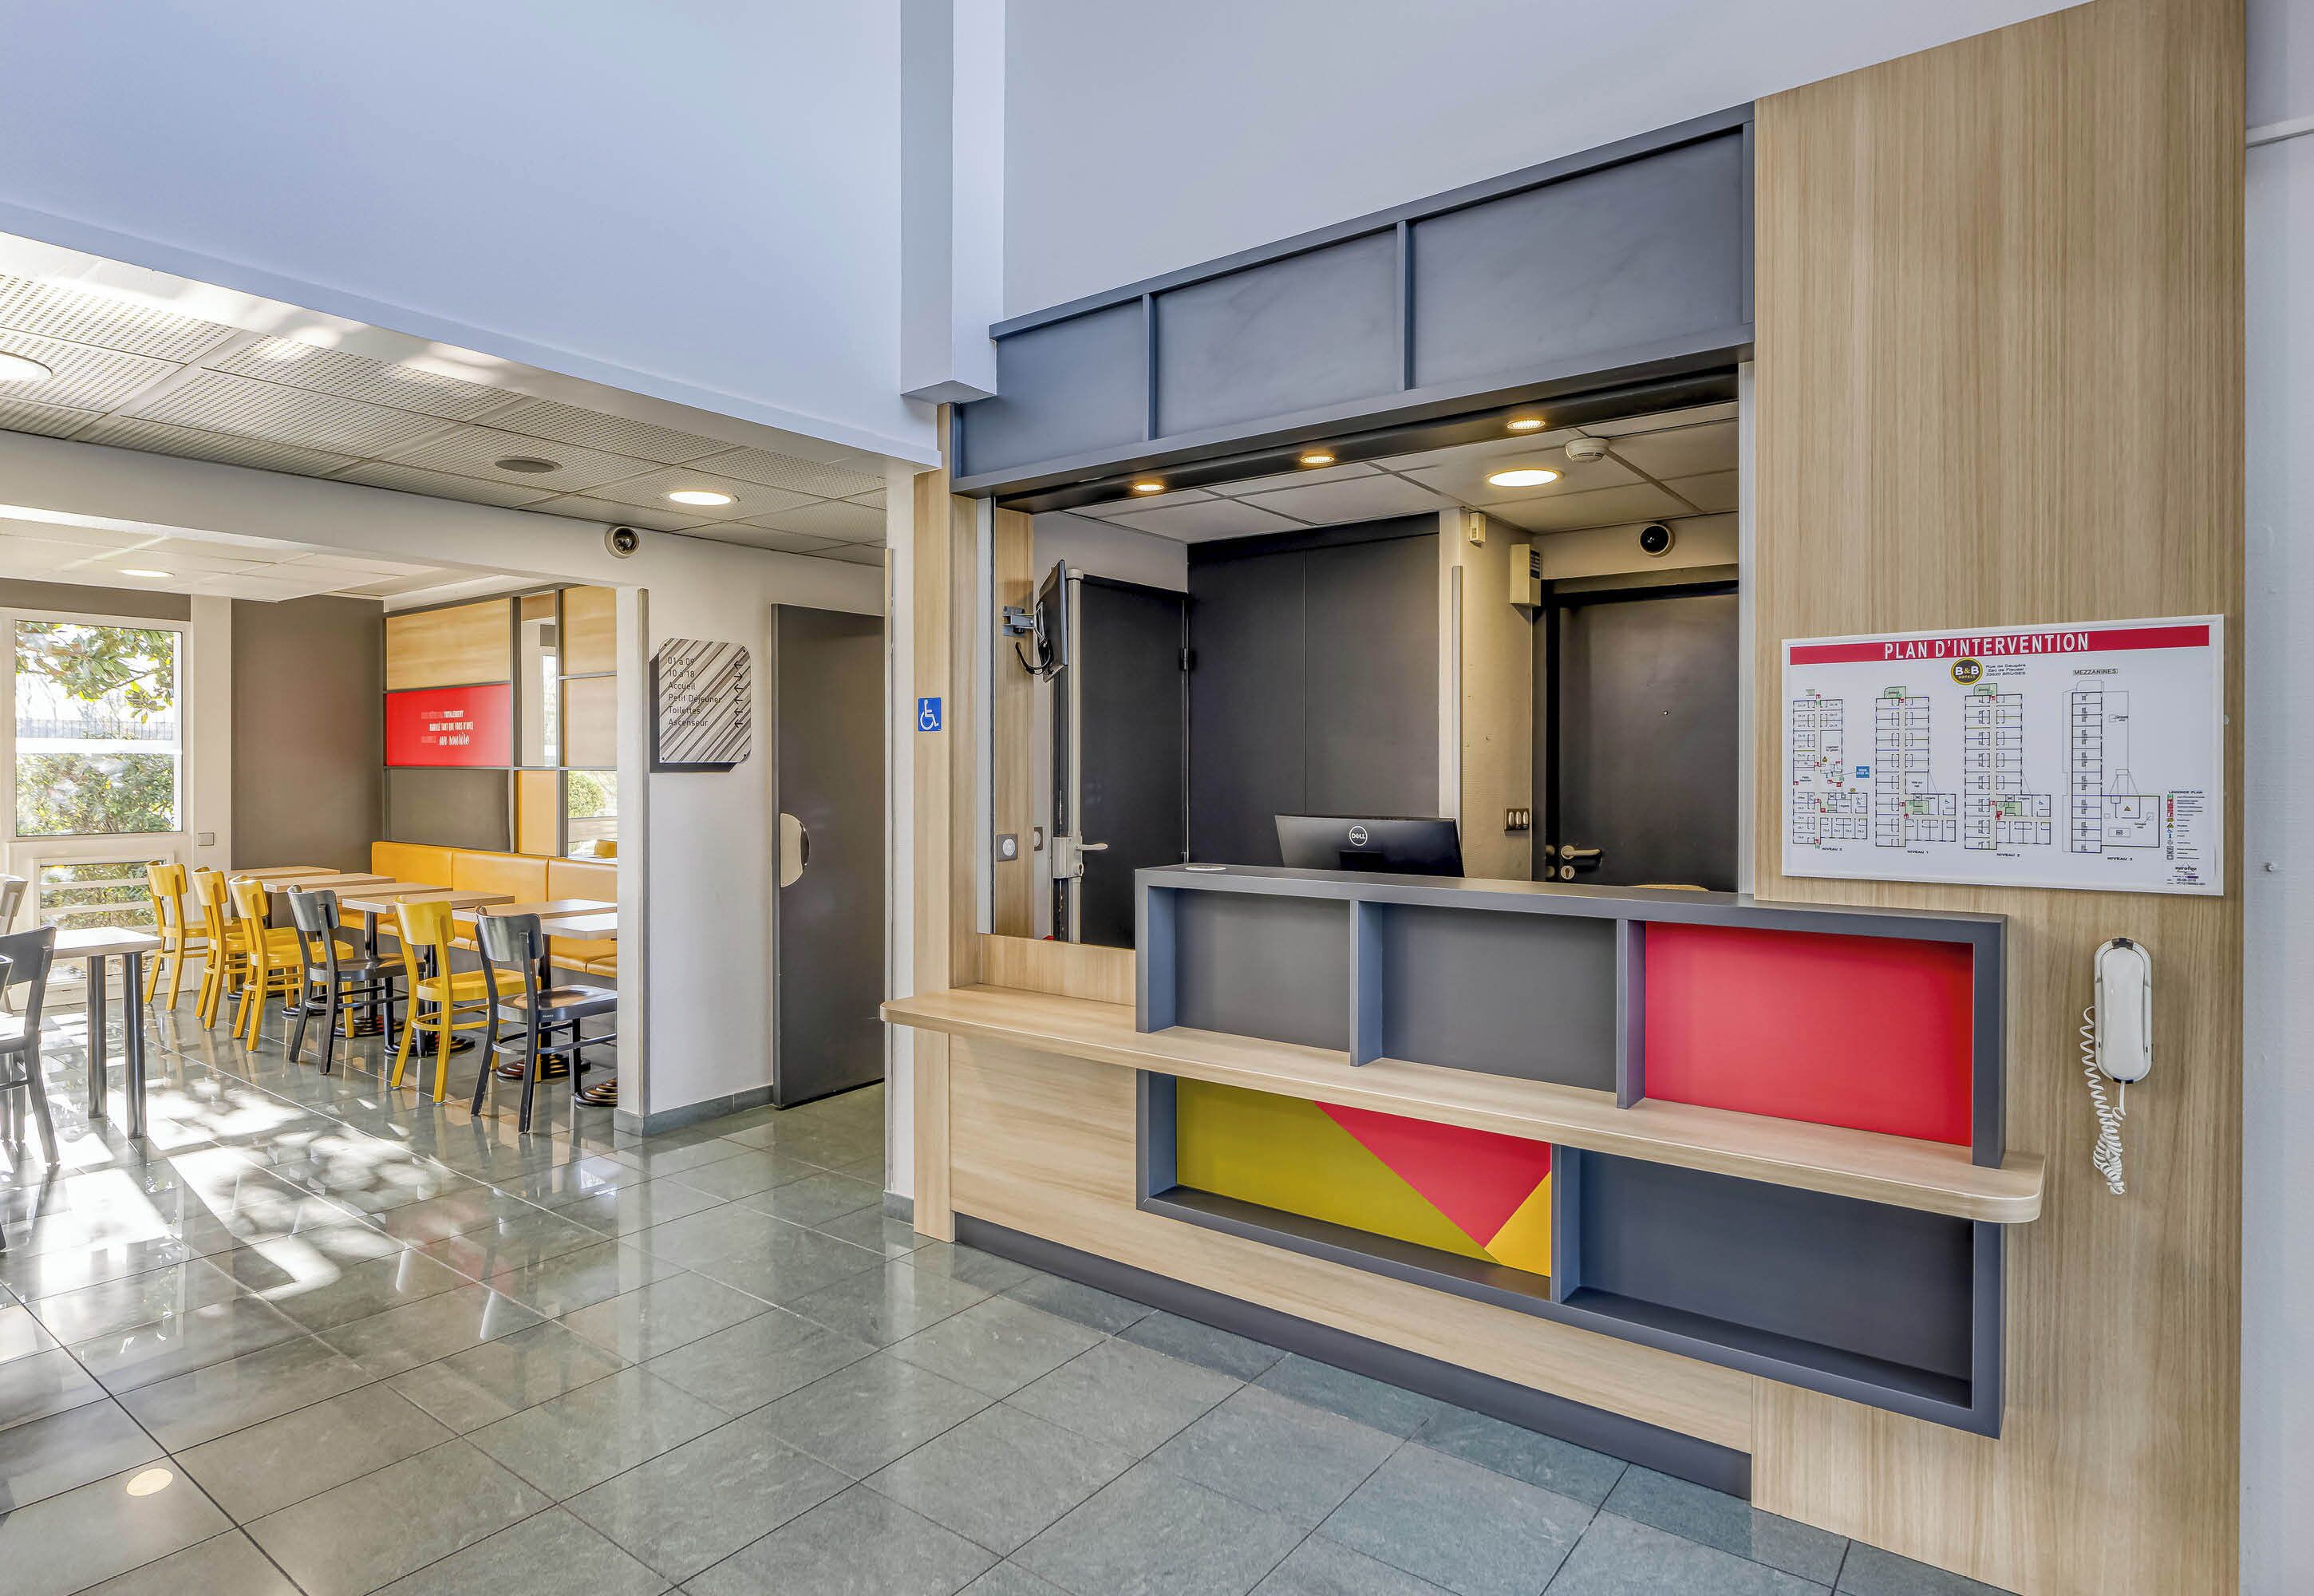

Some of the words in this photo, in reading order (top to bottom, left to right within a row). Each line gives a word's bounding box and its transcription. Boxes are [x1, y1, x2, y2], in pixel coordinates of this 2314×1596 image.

[1885, 641, 1928, 660] PLAN
[1935, 633, 2089, 658] D'INTERVENTION
[1955, 666, 1979, 676] B&B
[668, 681, 696, 690] Accueil
[688, 694, 721, 704] Déjeuner
[669, 705, 701, 714] Toilettes
[668, 718, 709, 727] Ascenseur
